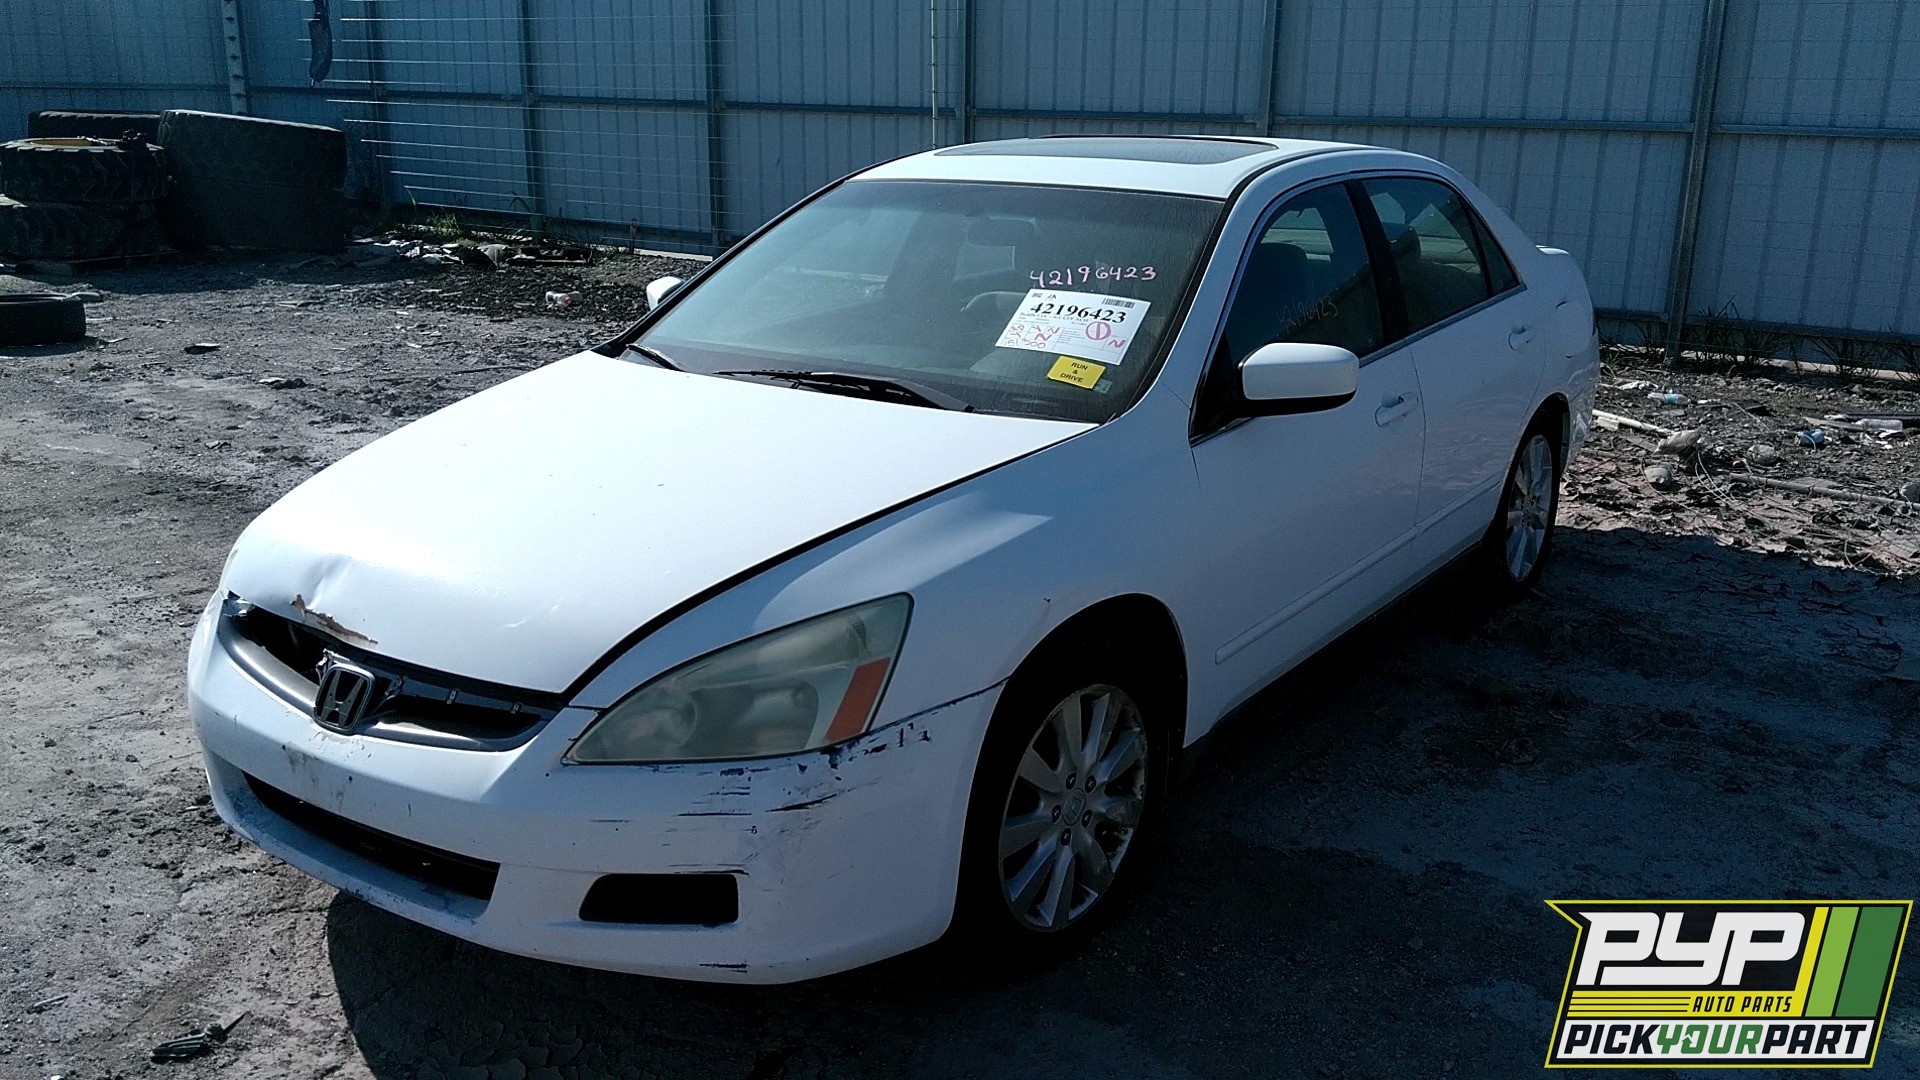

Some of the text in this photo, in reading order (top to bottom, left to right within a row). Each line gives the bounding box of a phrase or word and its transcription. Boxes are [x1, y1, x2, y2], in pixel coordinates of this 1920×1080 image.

[1030, 265, 1157, 288] 42196423
[1030, 302, 1127, 324] 42196423
[1071, 362, 1088, 371] RUN
[1060, 372, 1084, 383] DRIVE
